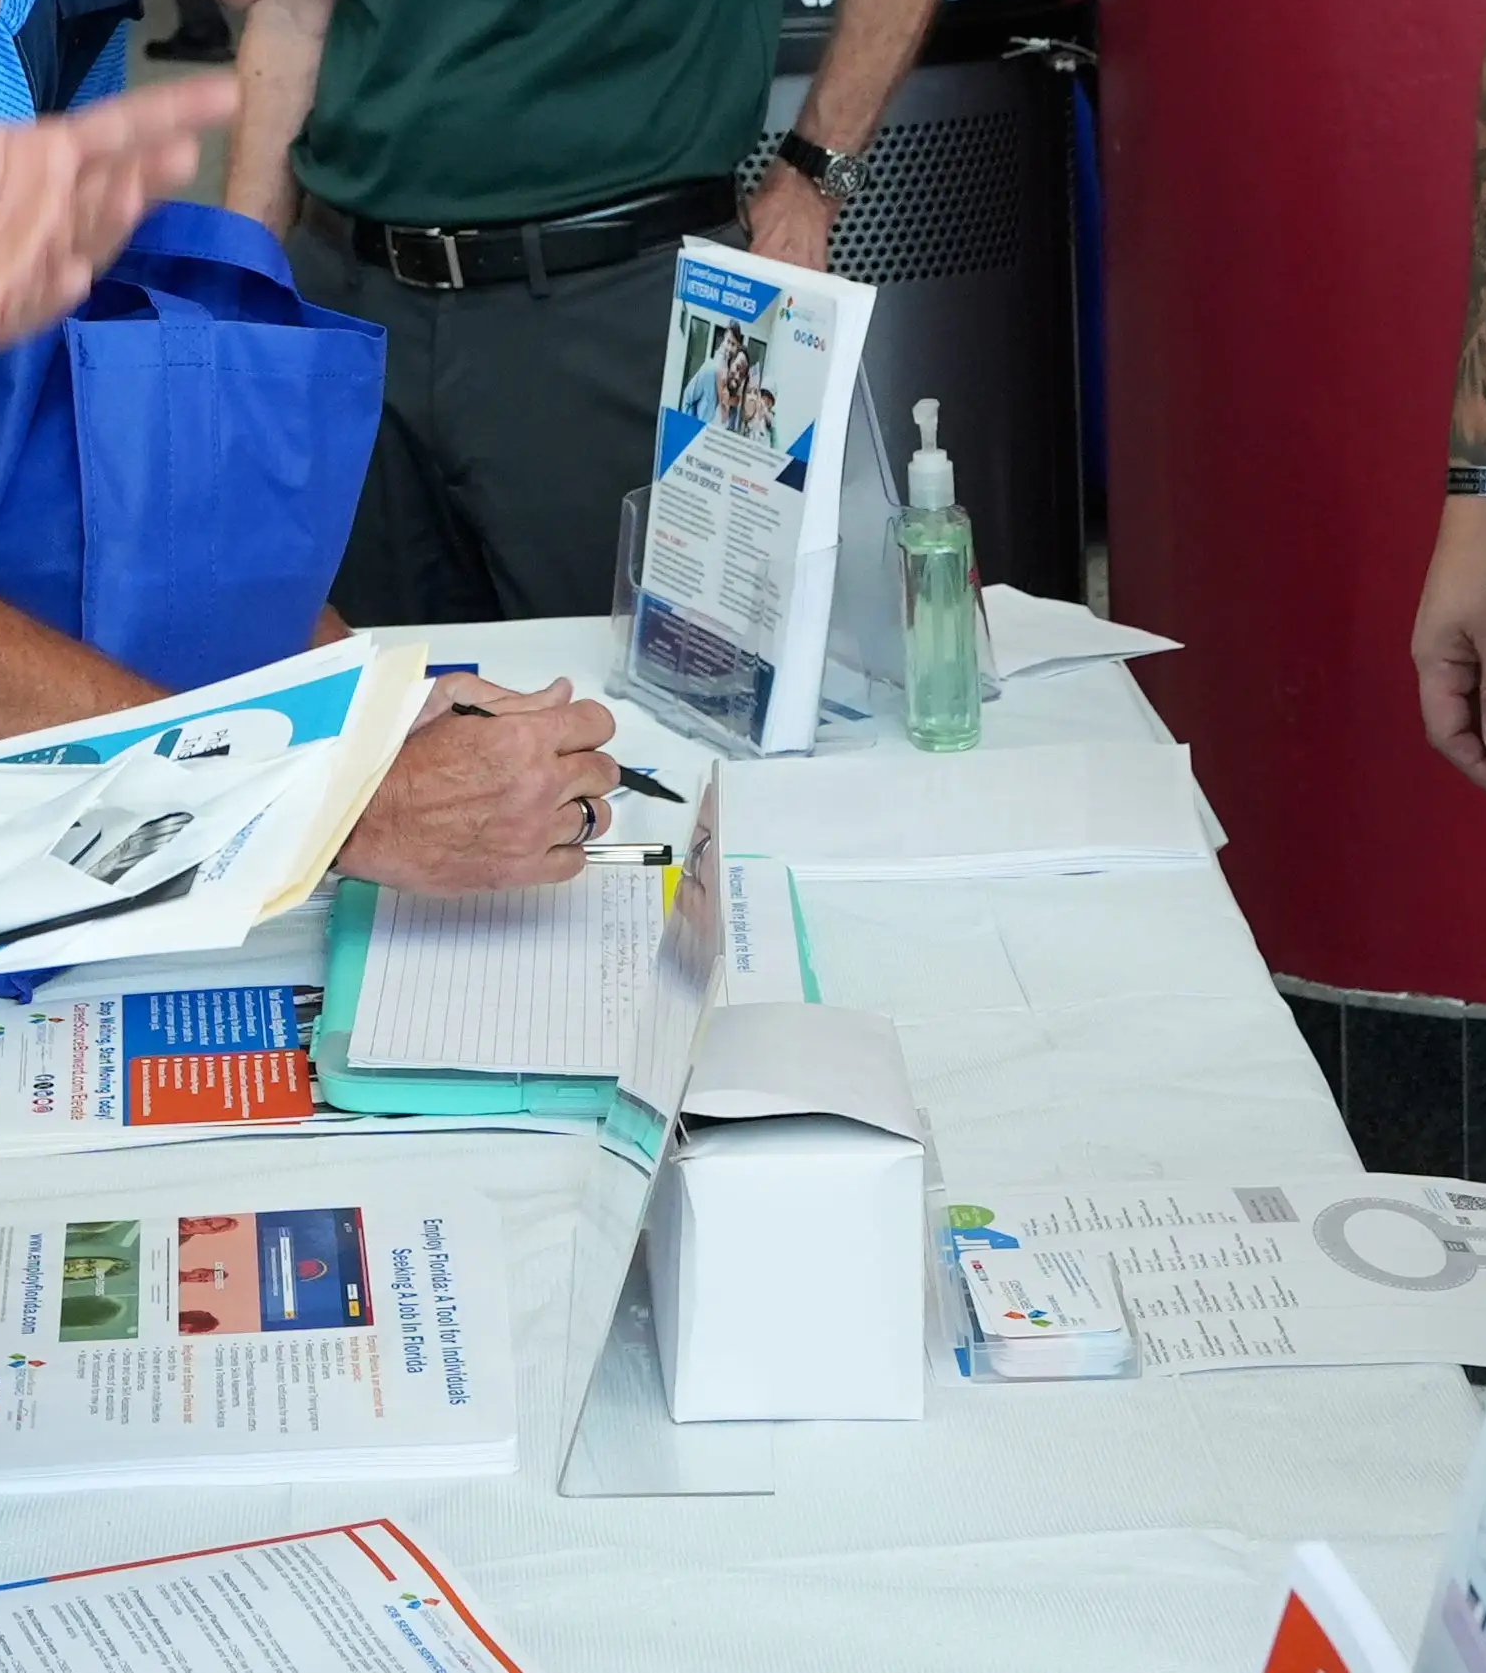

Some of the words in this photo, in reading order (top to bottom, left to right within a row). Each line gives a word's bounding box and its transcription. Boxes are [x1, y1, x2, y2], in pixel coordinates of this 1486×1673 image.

[96, 1000, 116, 1016] Stop
[95, 1016, 117, 1046] Waiting,
[98, 1047, 116, 1065] Start
[95, 1065, 117, 1093] Moving
[95, 1094, 117, 1121] Today!
[421, 1218, 445, 1252] Employ
[391, 1247, 416, 1290] Seeking
[428, 1253, 454, 1292] Florida:
[21, 1233, 46, 1335] www.employflorida.com
[396, 1291, 418, 1300] A
[398, 1301, 420, 1320] Job
[433, 1294, 456, 1303] A
[401, 1322, 423, 1334] In
[435, 1304, 459, 1327] Tool
[438, 1329, 462, 1344] for
[402, 1335, 428, 1374] Florida
[440, 1346, 472, 1406] Individuals
[381, 1604, 402, 1618] JOB
[392, 1619, 424, 1646] SEEKER
